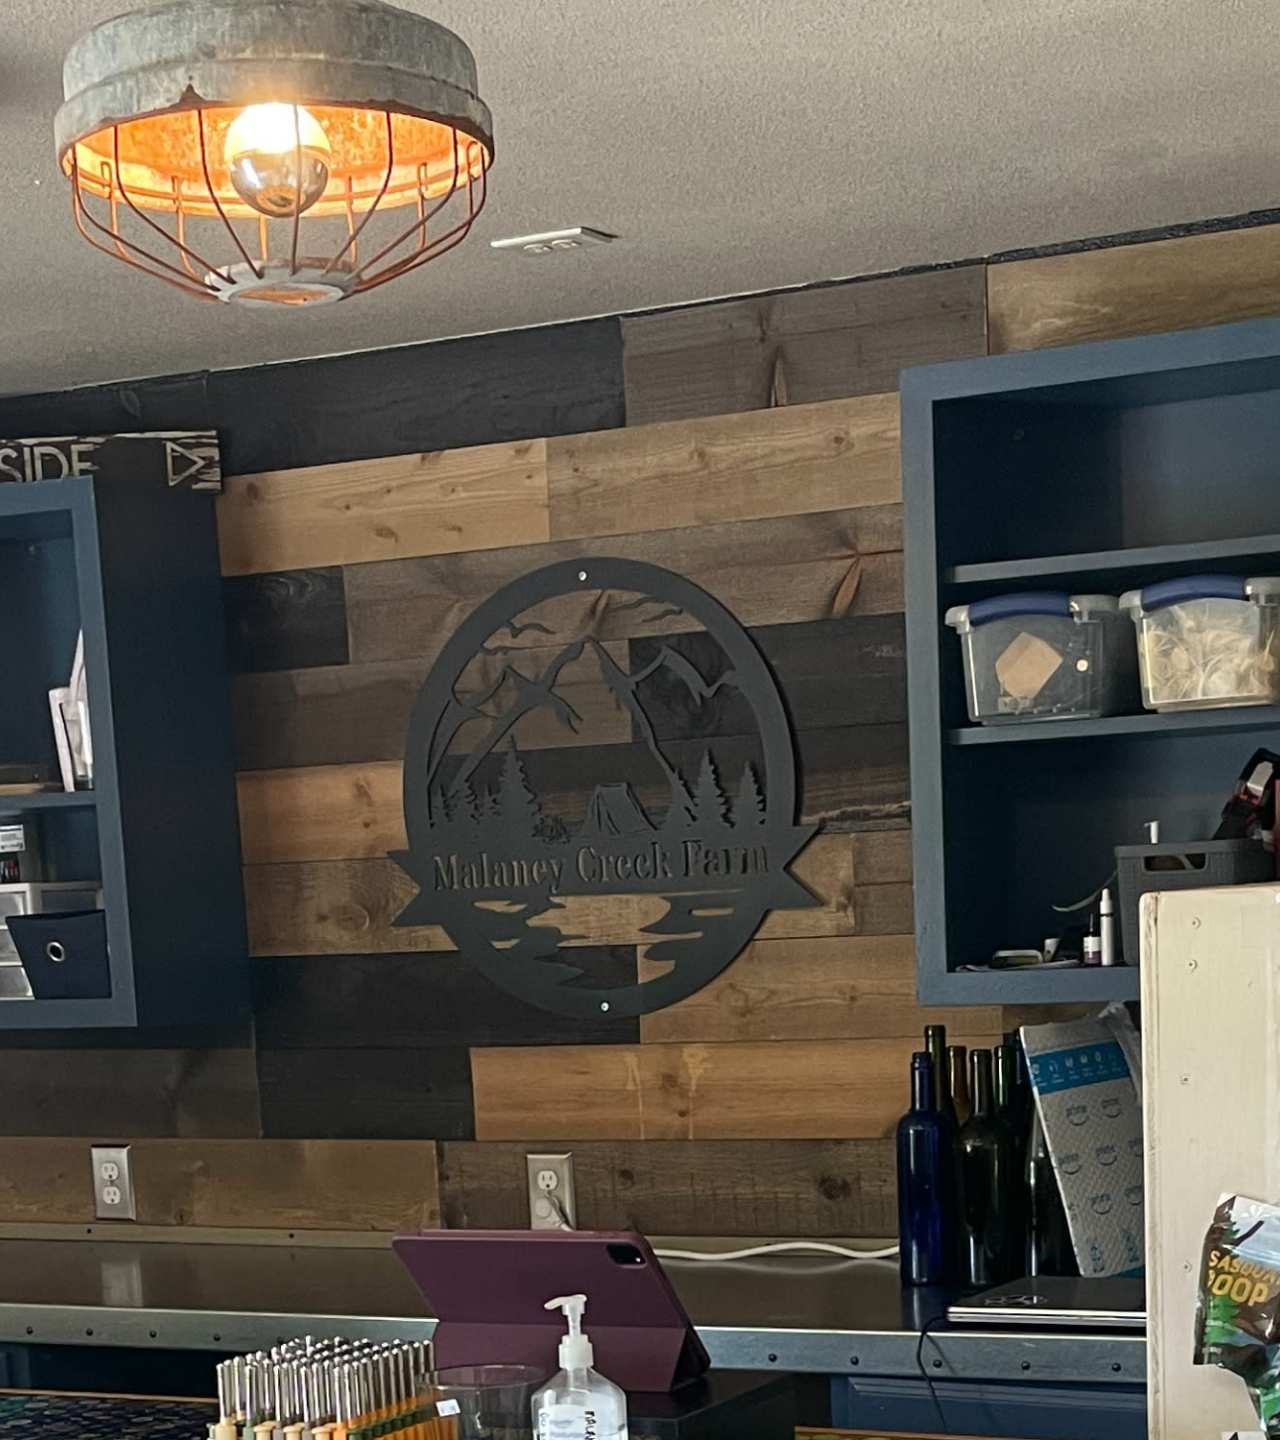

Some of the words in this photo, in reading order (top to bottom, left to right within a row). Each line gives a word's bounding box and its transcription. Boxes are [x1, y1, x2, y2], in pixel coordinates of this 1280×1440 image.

[433, 853, 565, 894] Malaney
[576, 841, 671, 882] Creek
[681, 839, 769, 877] Farm
